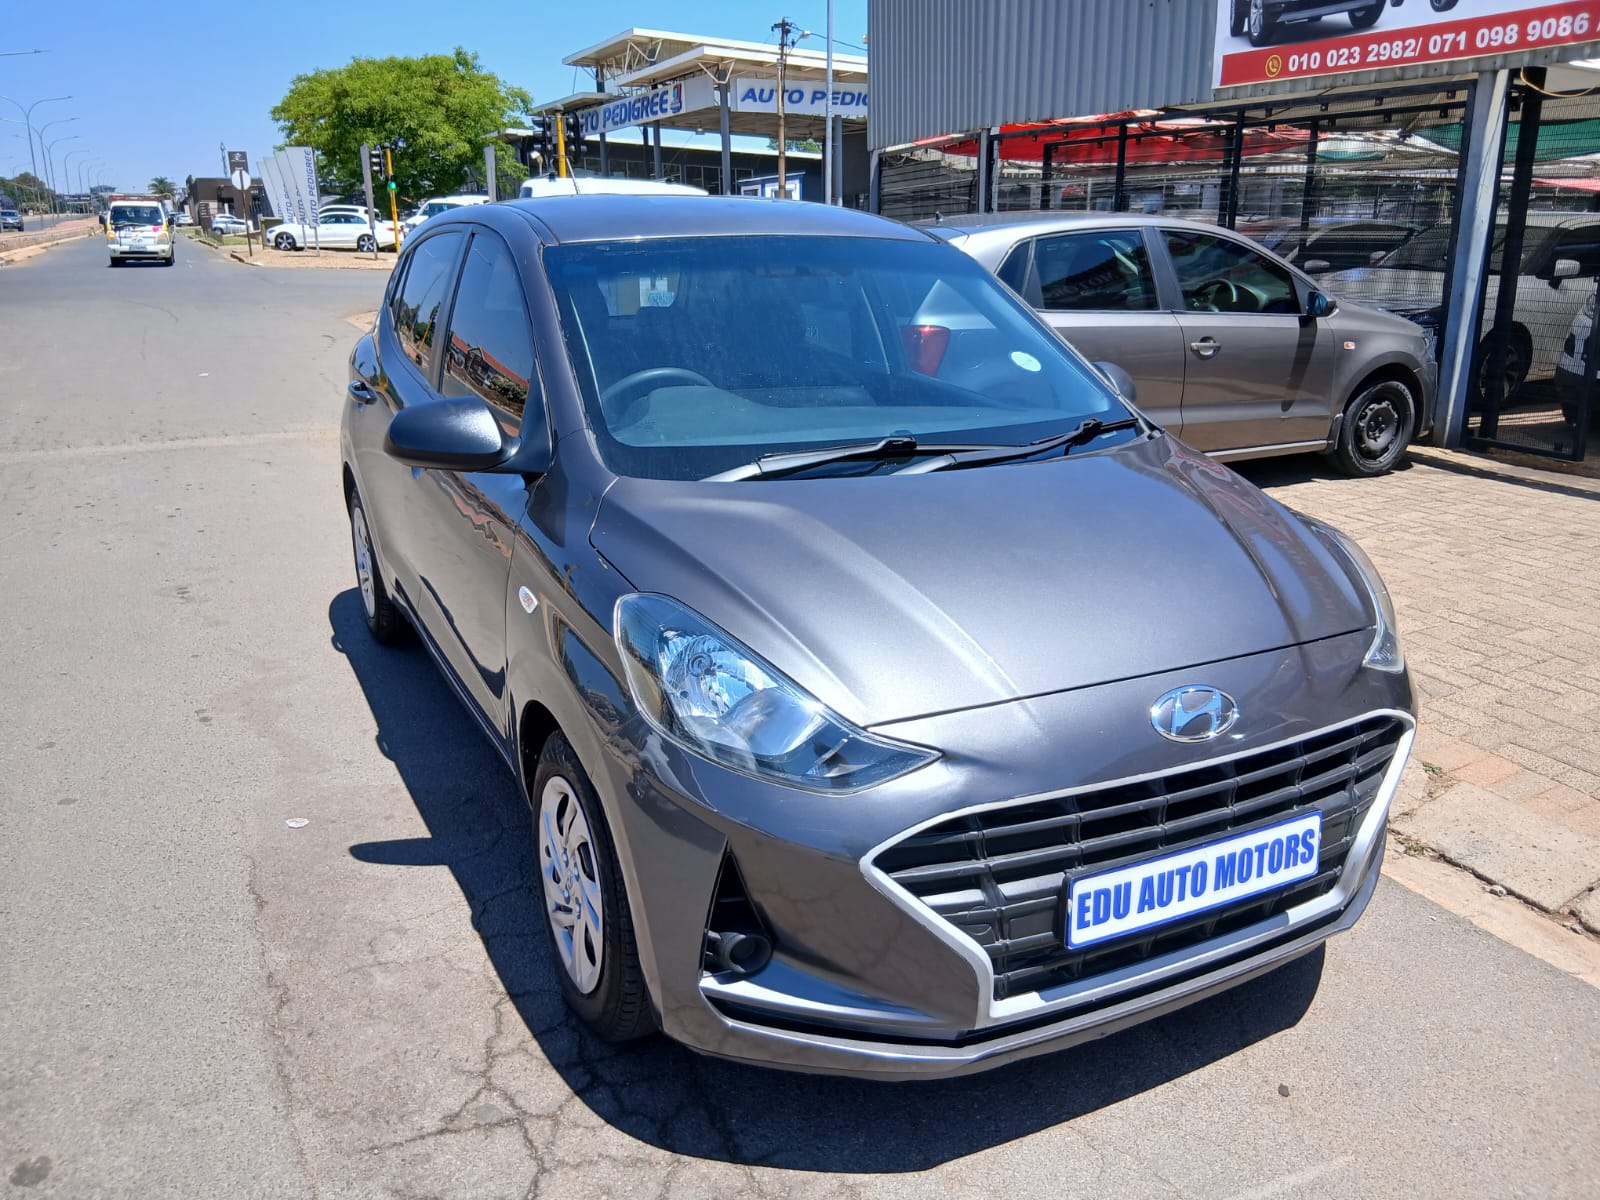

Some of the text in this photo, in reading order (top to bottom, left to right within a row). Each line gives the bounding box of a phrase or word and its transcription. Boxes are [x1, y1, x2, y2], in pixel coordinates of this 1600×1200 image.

[1288, 12, 1590, 72] 010 023 2982/ 071 098 9086
[602, 89, 669, 129] PEDIGREE
[303, 148, 320, 226] AUTO PEDIGREE
[1076, 828, 1315, 930] EDU AUTO MOTORS
